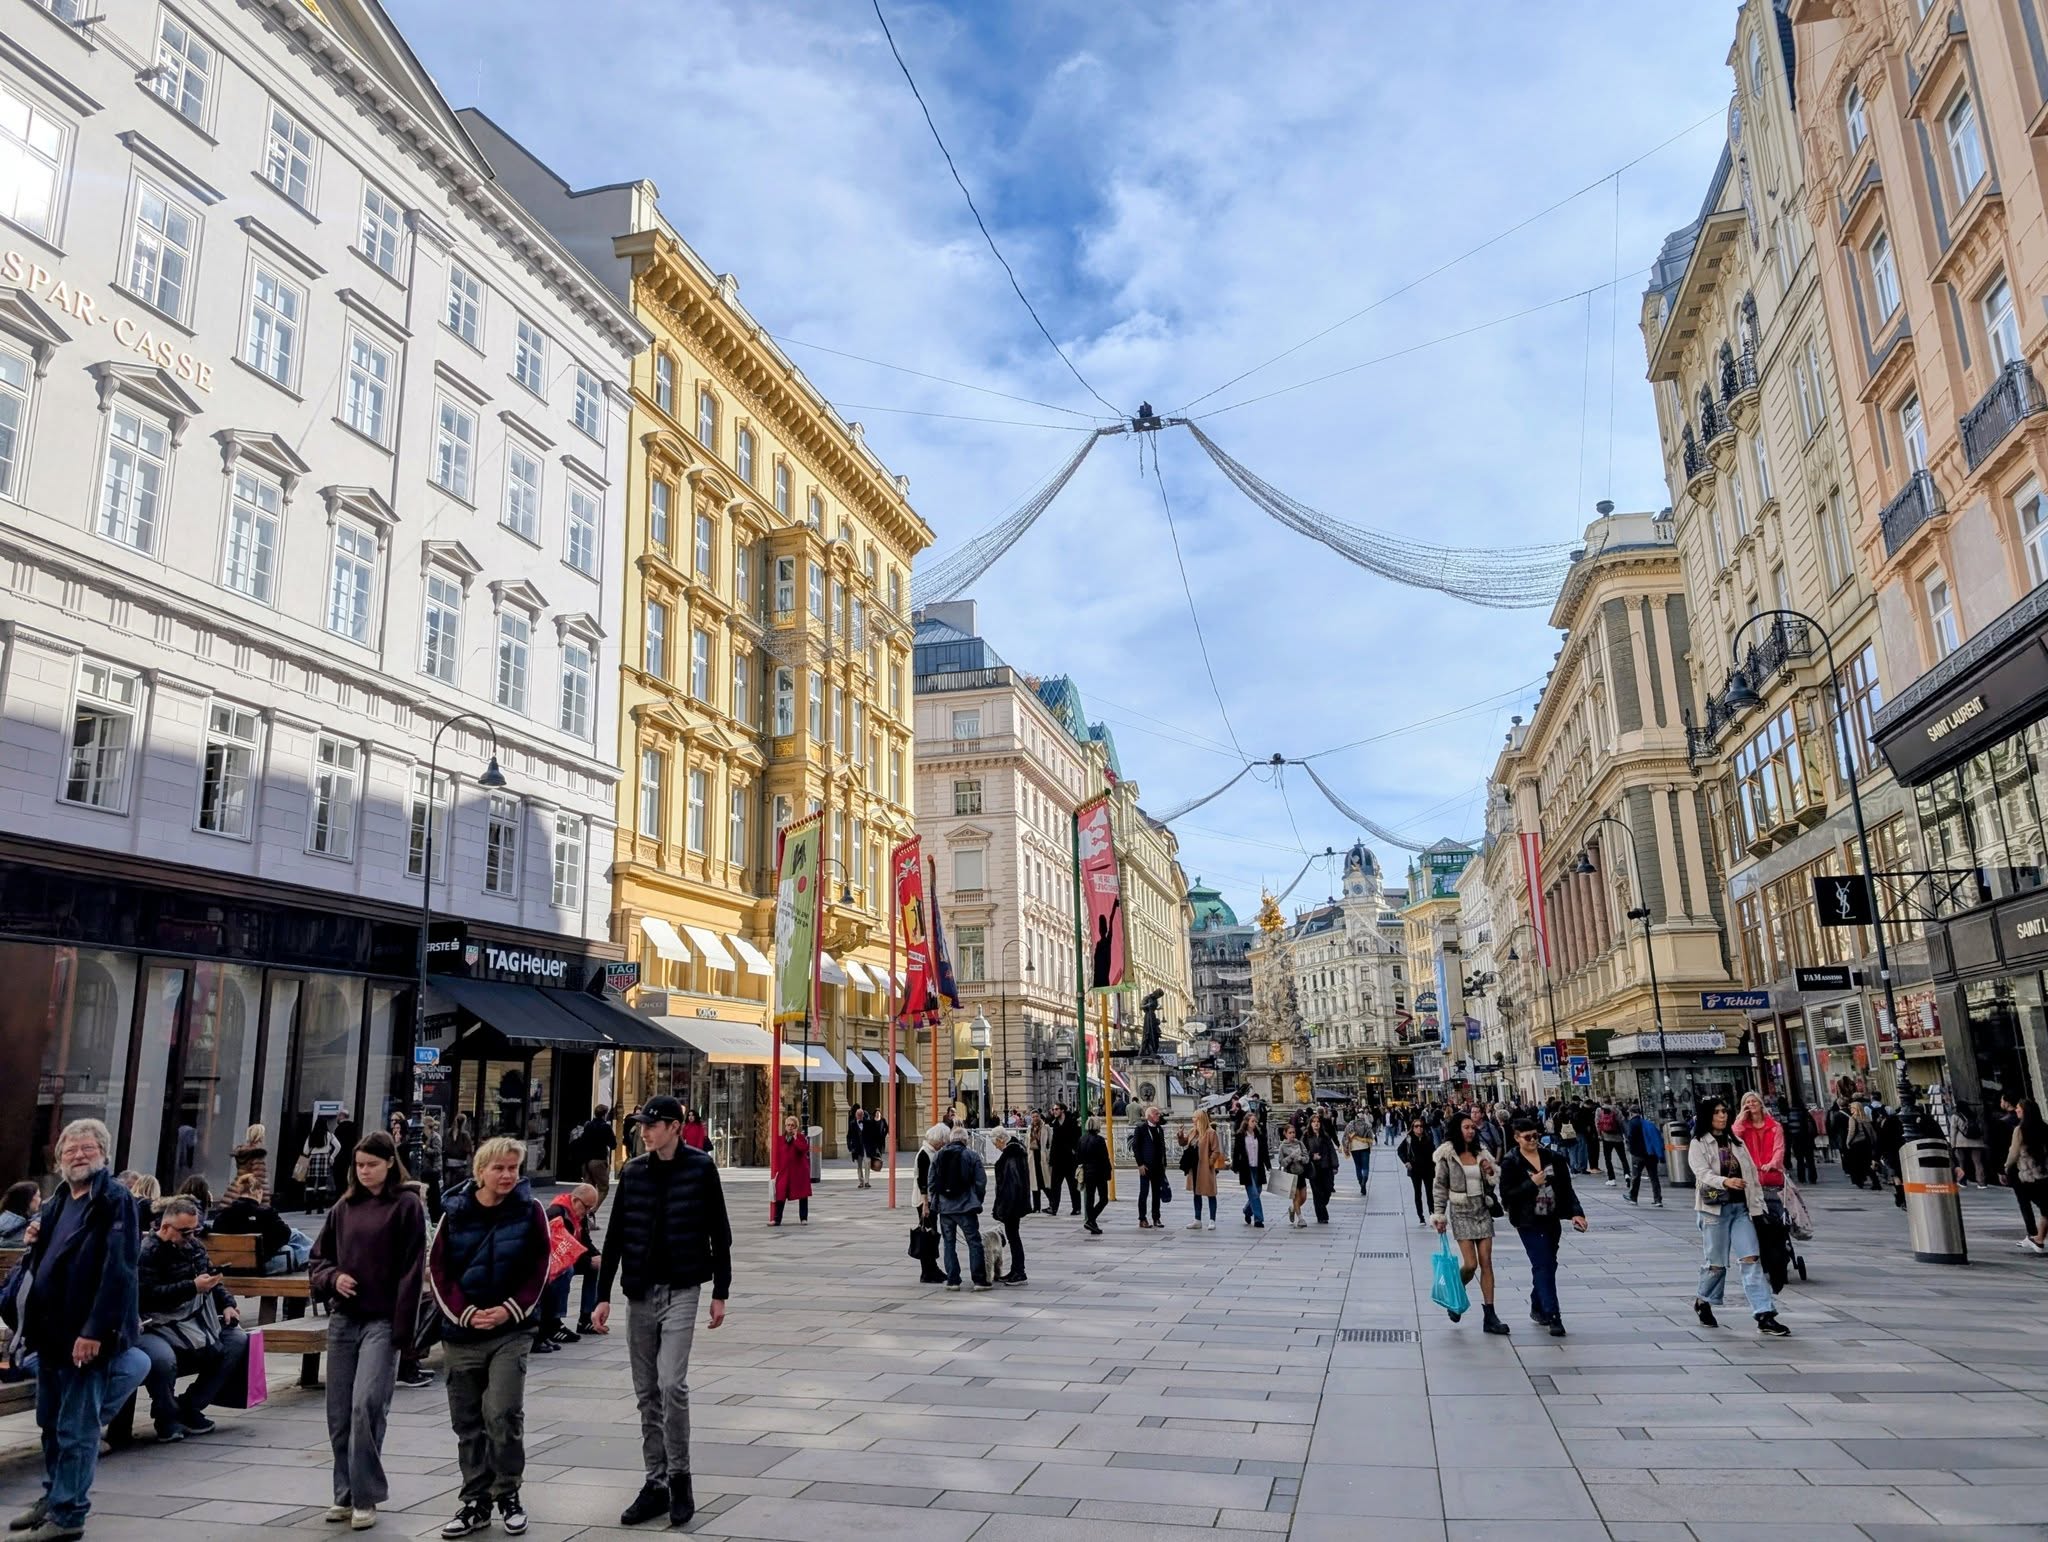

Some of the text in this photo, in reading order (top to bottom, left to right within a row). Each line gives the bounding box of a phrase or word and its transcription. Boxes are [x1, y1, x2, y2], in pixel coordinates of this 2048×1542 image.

[1, 251, 214, 393] SPAR-CASSE
[1927, 696, 1984, 742] SAINT LAURENT
[2017, 919, 2041, 939] SAINT
[609, 965, 634, 974] TAG
[608, 975, 634, 988] HEUER
[1723, 996, 1765, 1007] Tchibo
